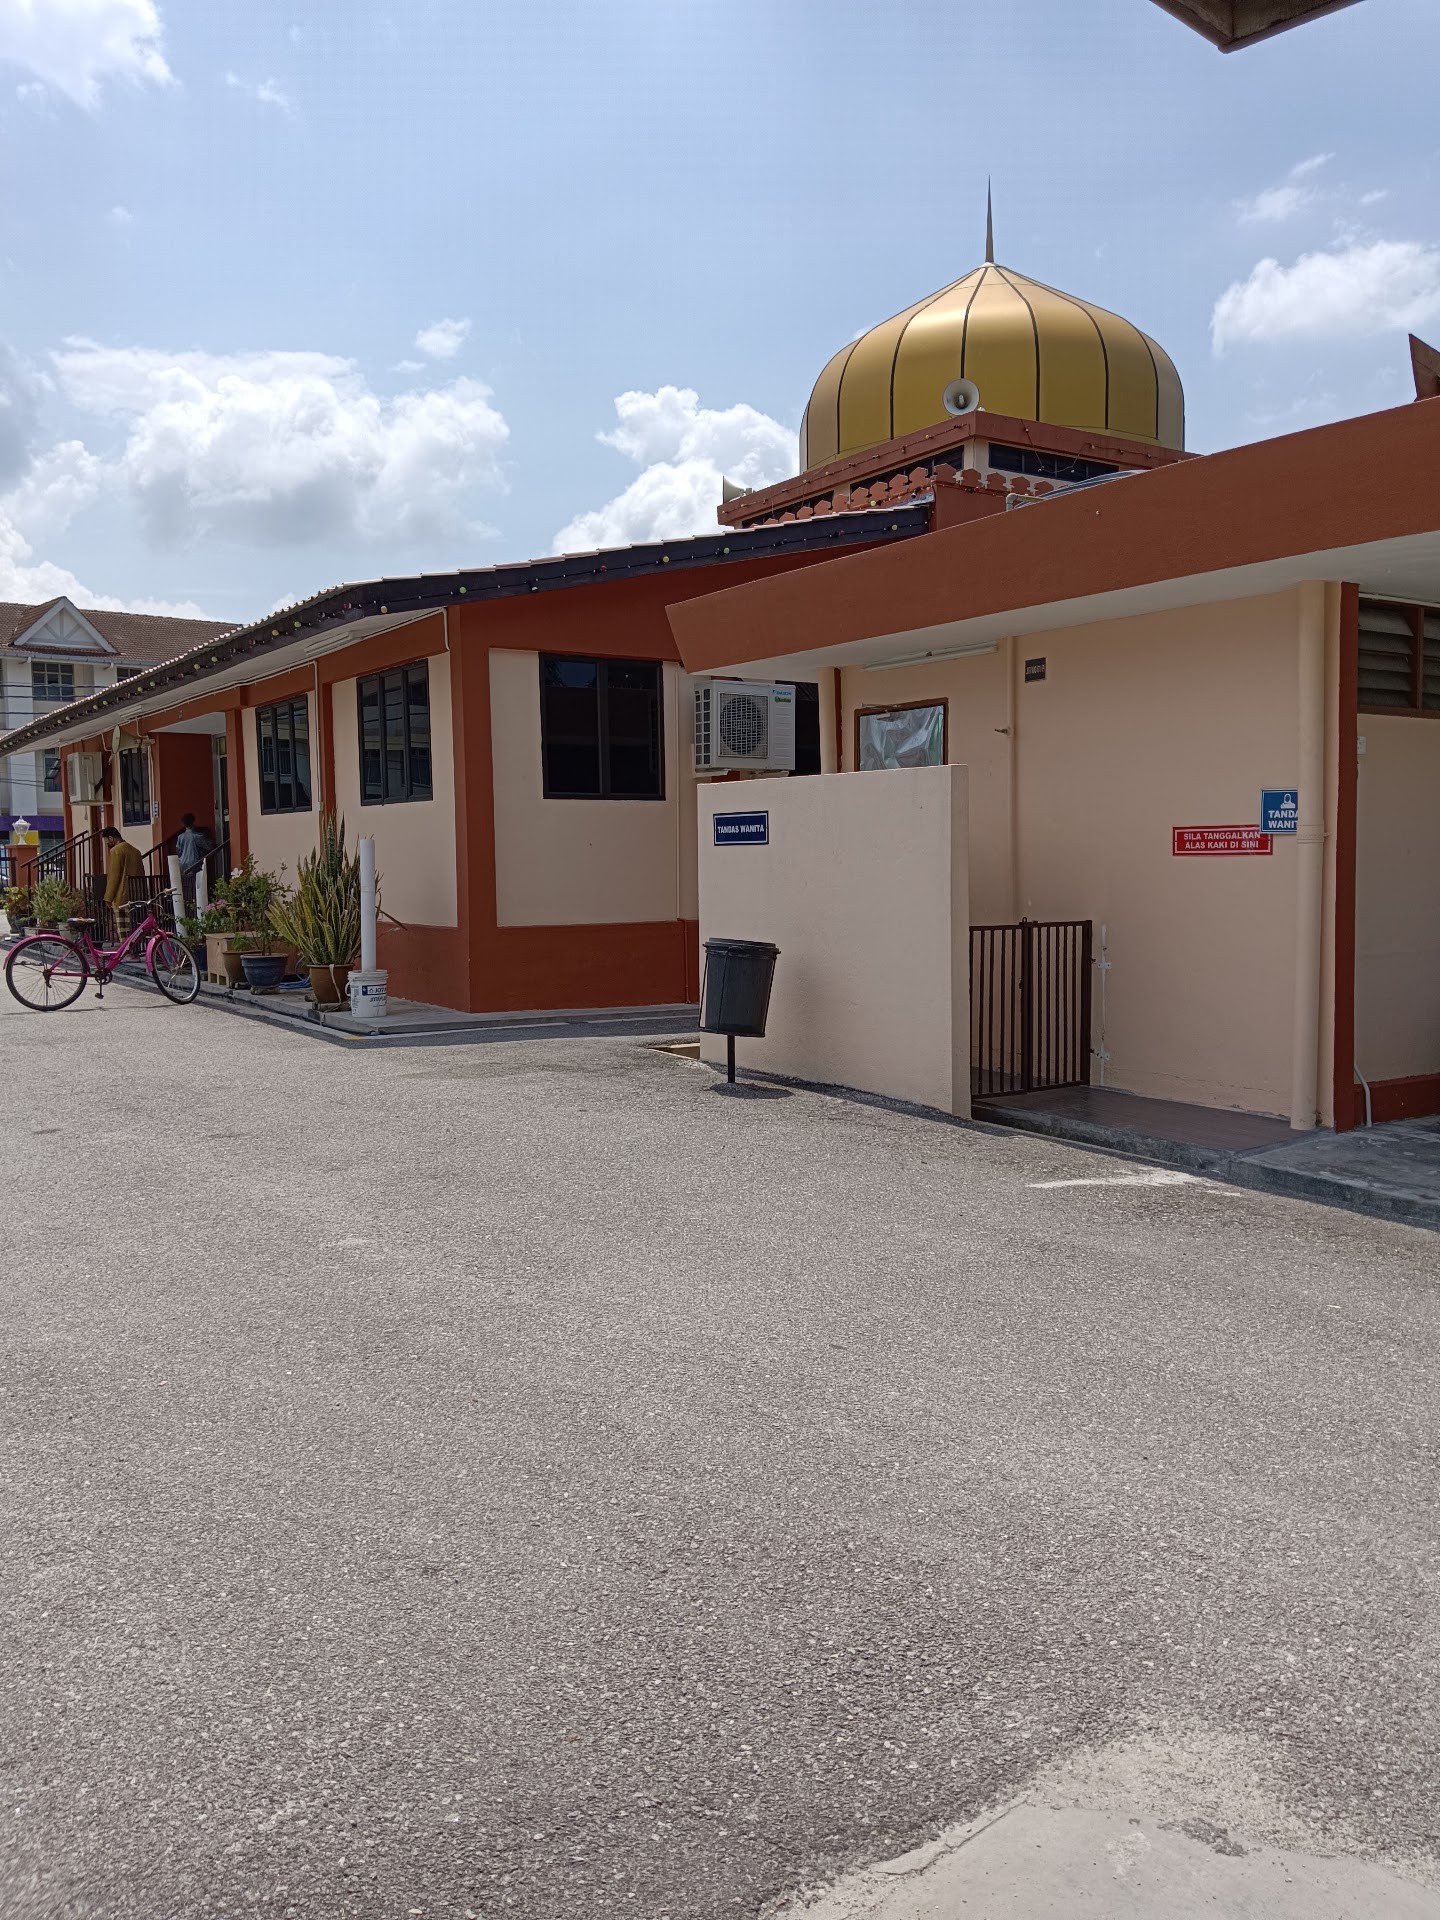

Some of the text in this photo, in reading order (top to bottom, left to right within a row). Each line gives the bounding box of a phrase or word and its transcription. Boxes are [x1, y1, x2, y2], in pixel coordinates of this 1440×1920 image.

[717, 824, 764, 834] TANDAS WANITA
[1183, 831, 1261, 840] SILA TANGGALKAN
[1185, 840, 1259, 849] ALAS KAKI DI SINI
